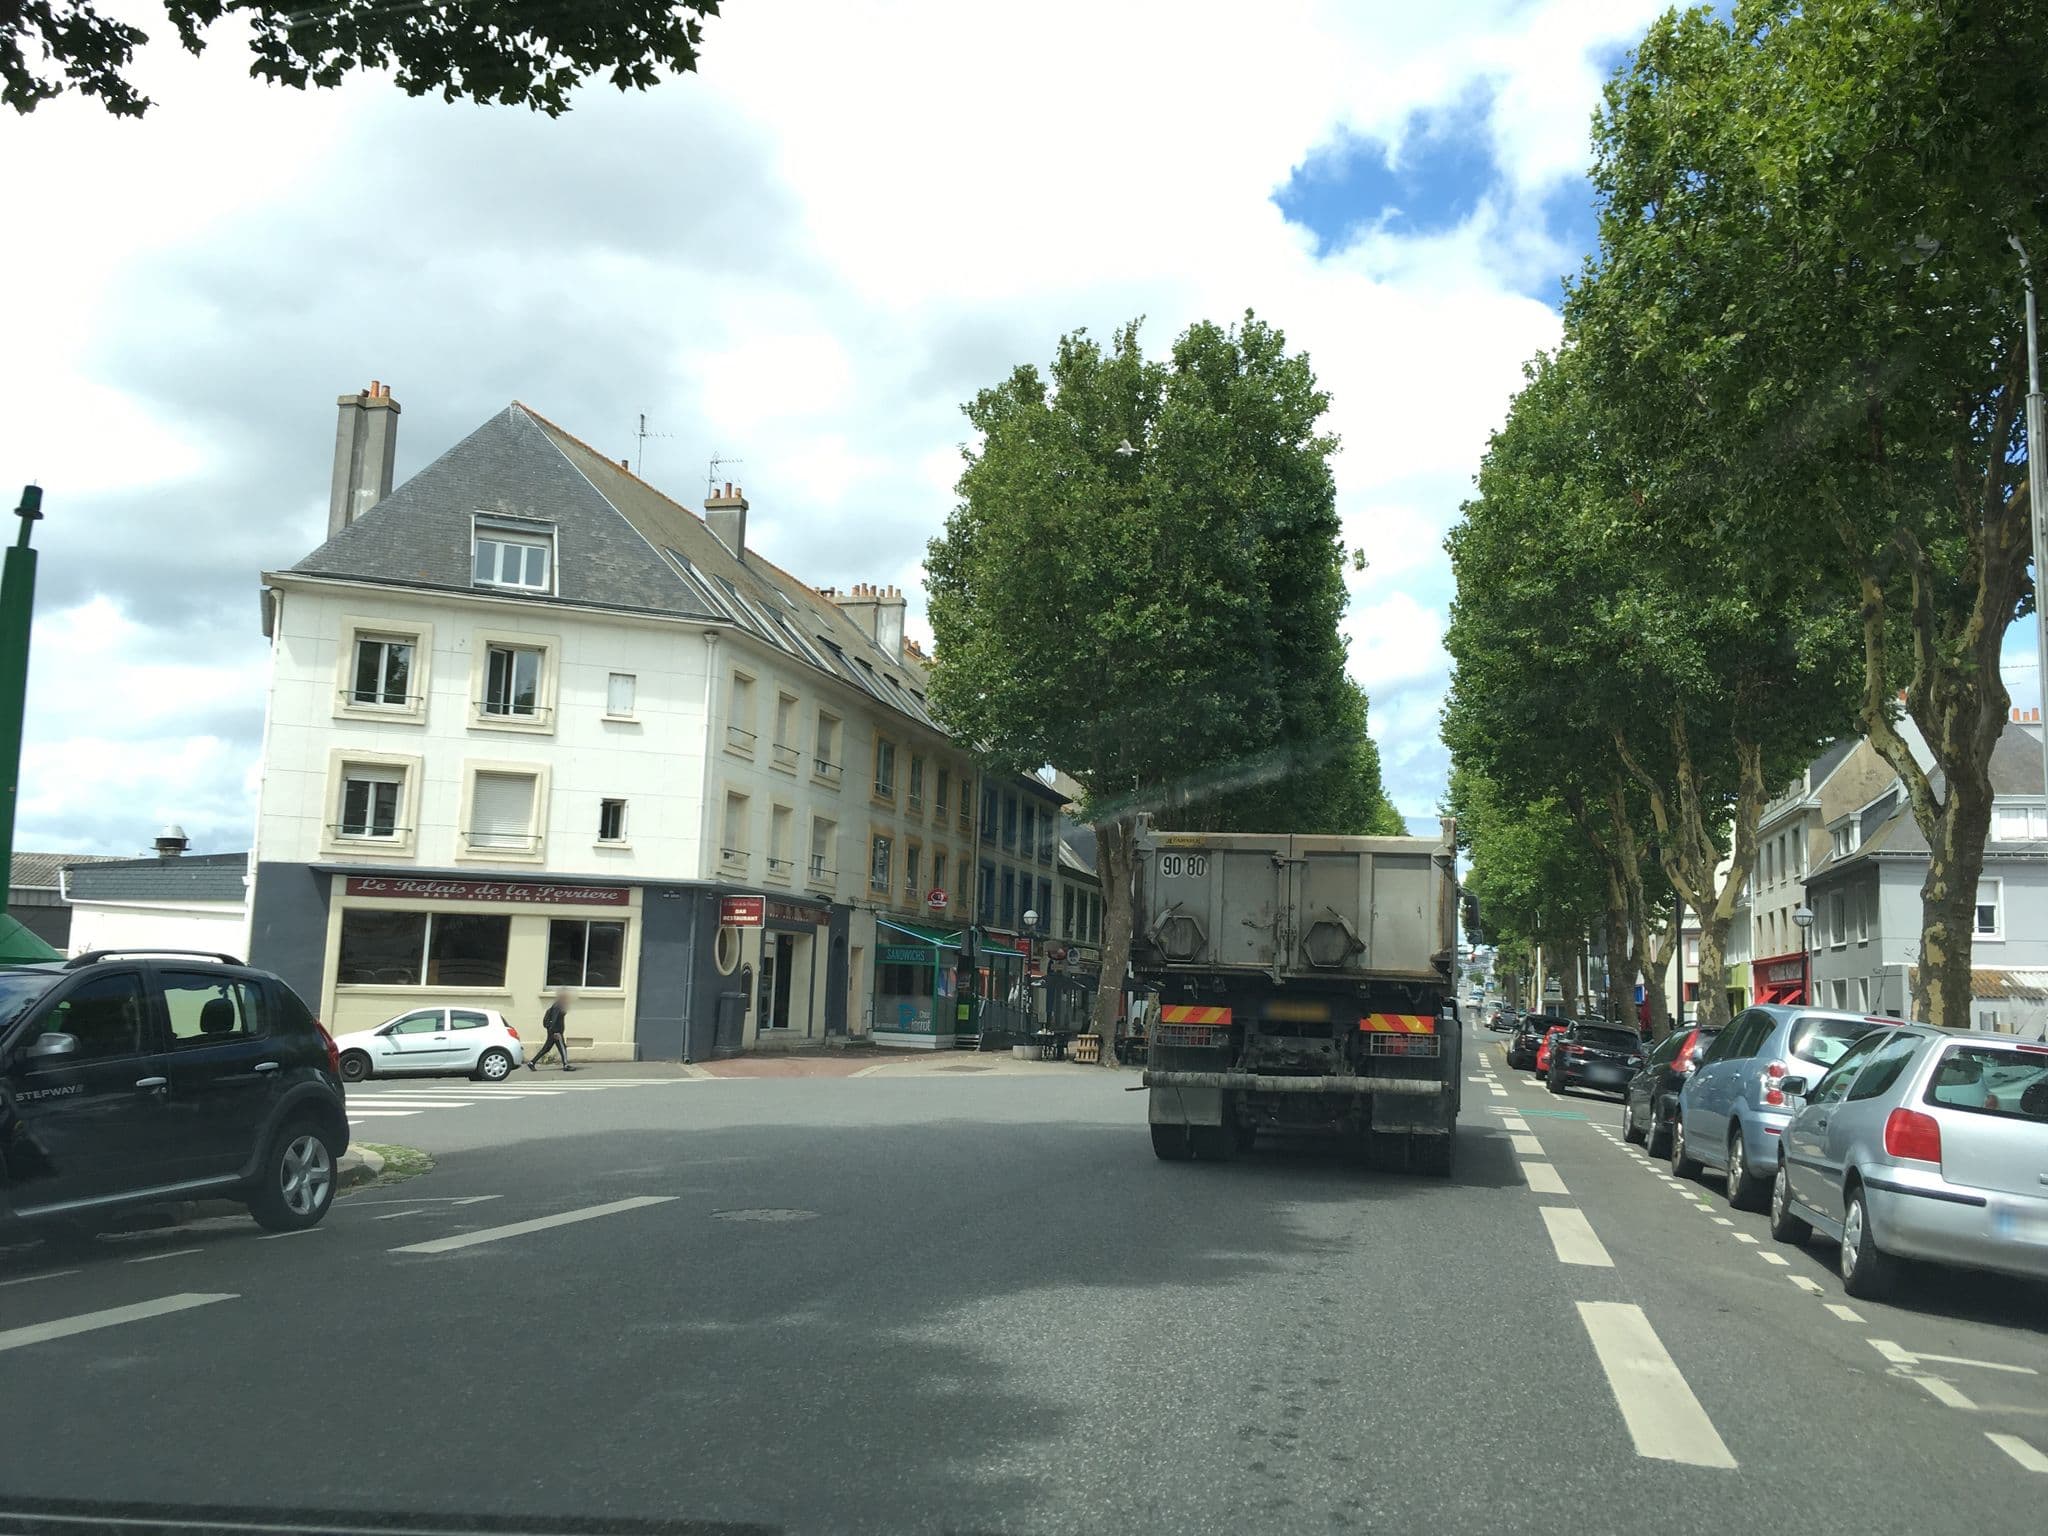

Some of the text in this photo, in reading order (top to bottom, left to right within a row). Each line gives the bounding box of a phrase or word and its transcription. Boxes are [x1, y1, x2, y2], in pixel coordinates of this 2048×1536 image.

[1163, 856, 1205, 877] 90 80
[358, 879, 388, 891] Le
[394, 880, 467, 894] Relais
[474, 884, 501, 895] de
[505, 885, 529, 896] la
[467, 894, 561, 903] RESTAURANT
[15, 1085, 76, 1102] STEPWAY
